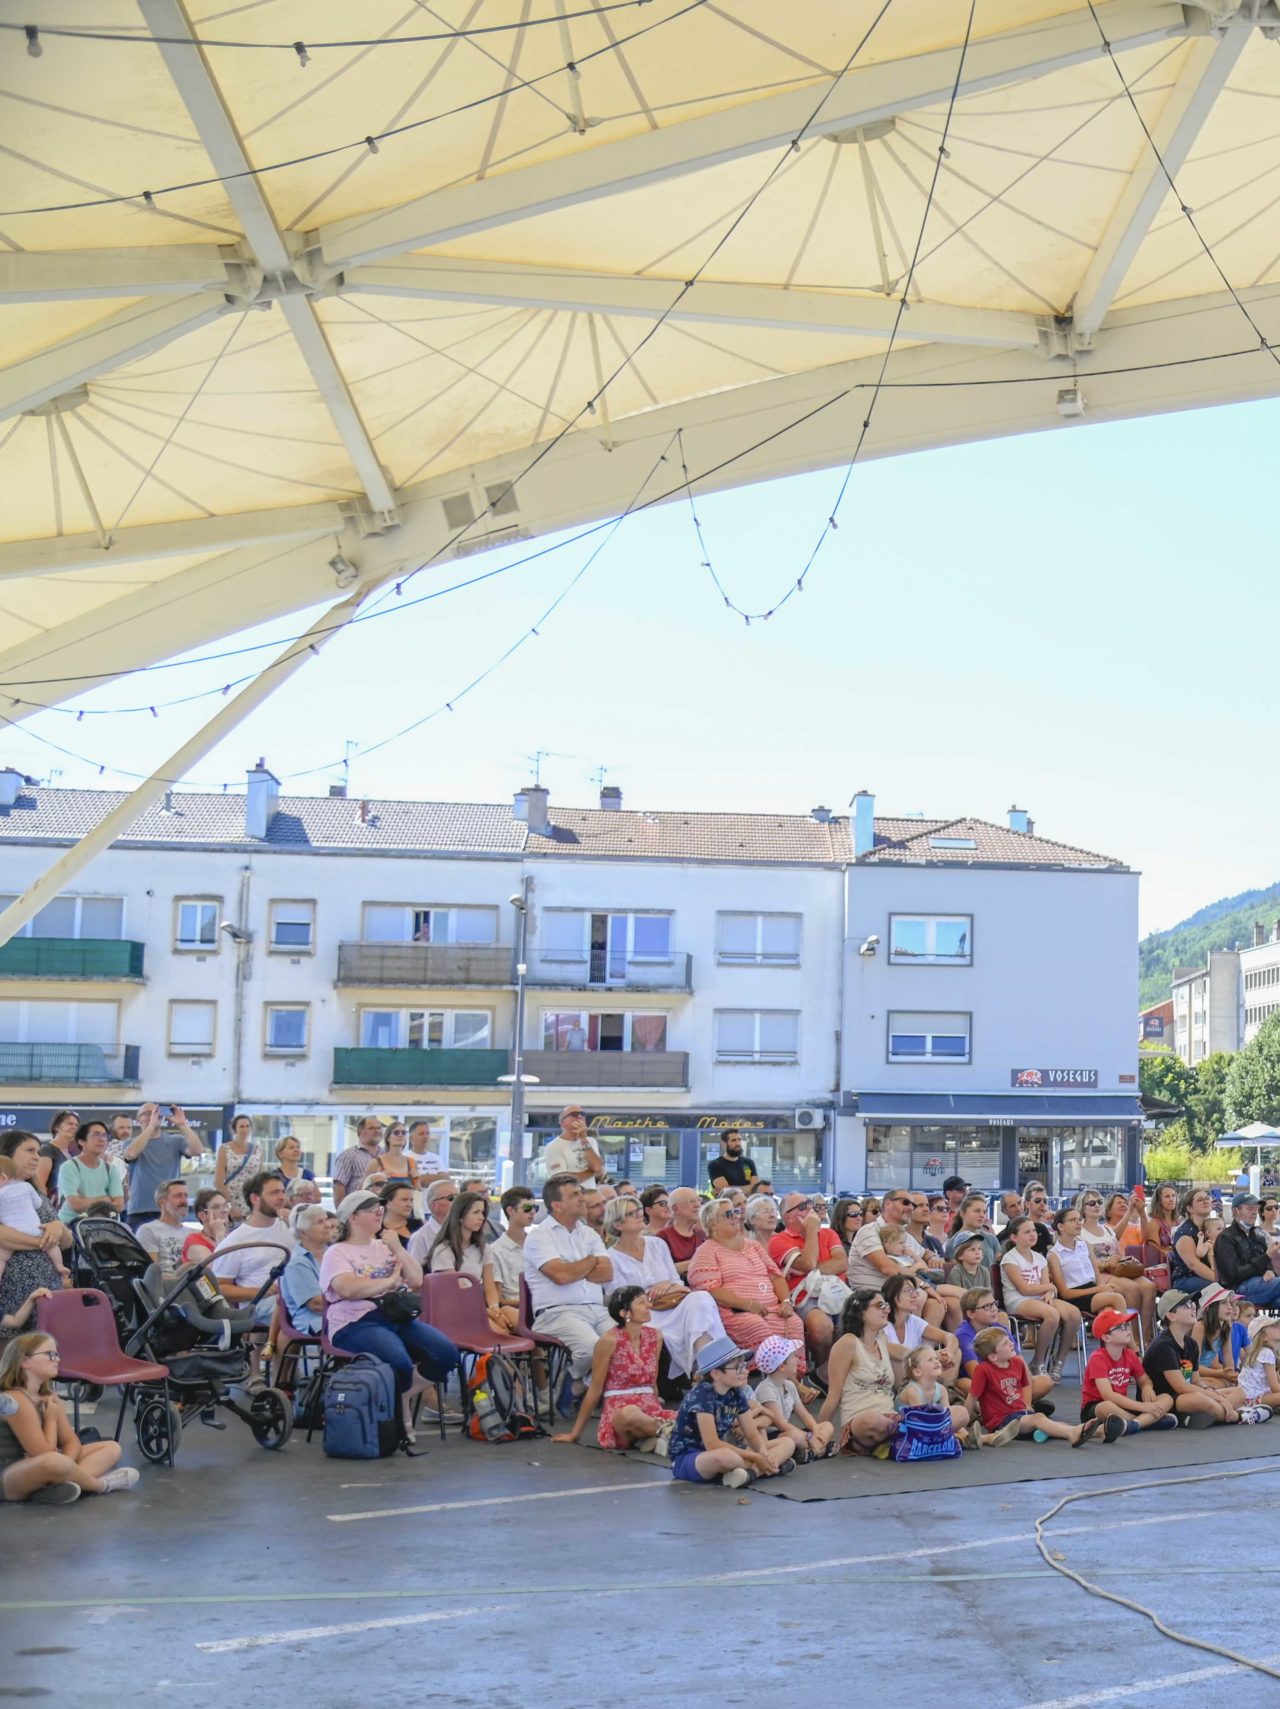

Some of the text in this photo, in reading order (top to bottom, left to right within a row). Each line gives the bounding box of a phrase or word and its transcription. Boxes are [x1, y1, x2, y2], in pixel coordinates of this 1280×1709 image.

[1048, 1070, 1096, 1082] VOSEGUS
[589, 1116, 765, 1129] Marthe Modes
